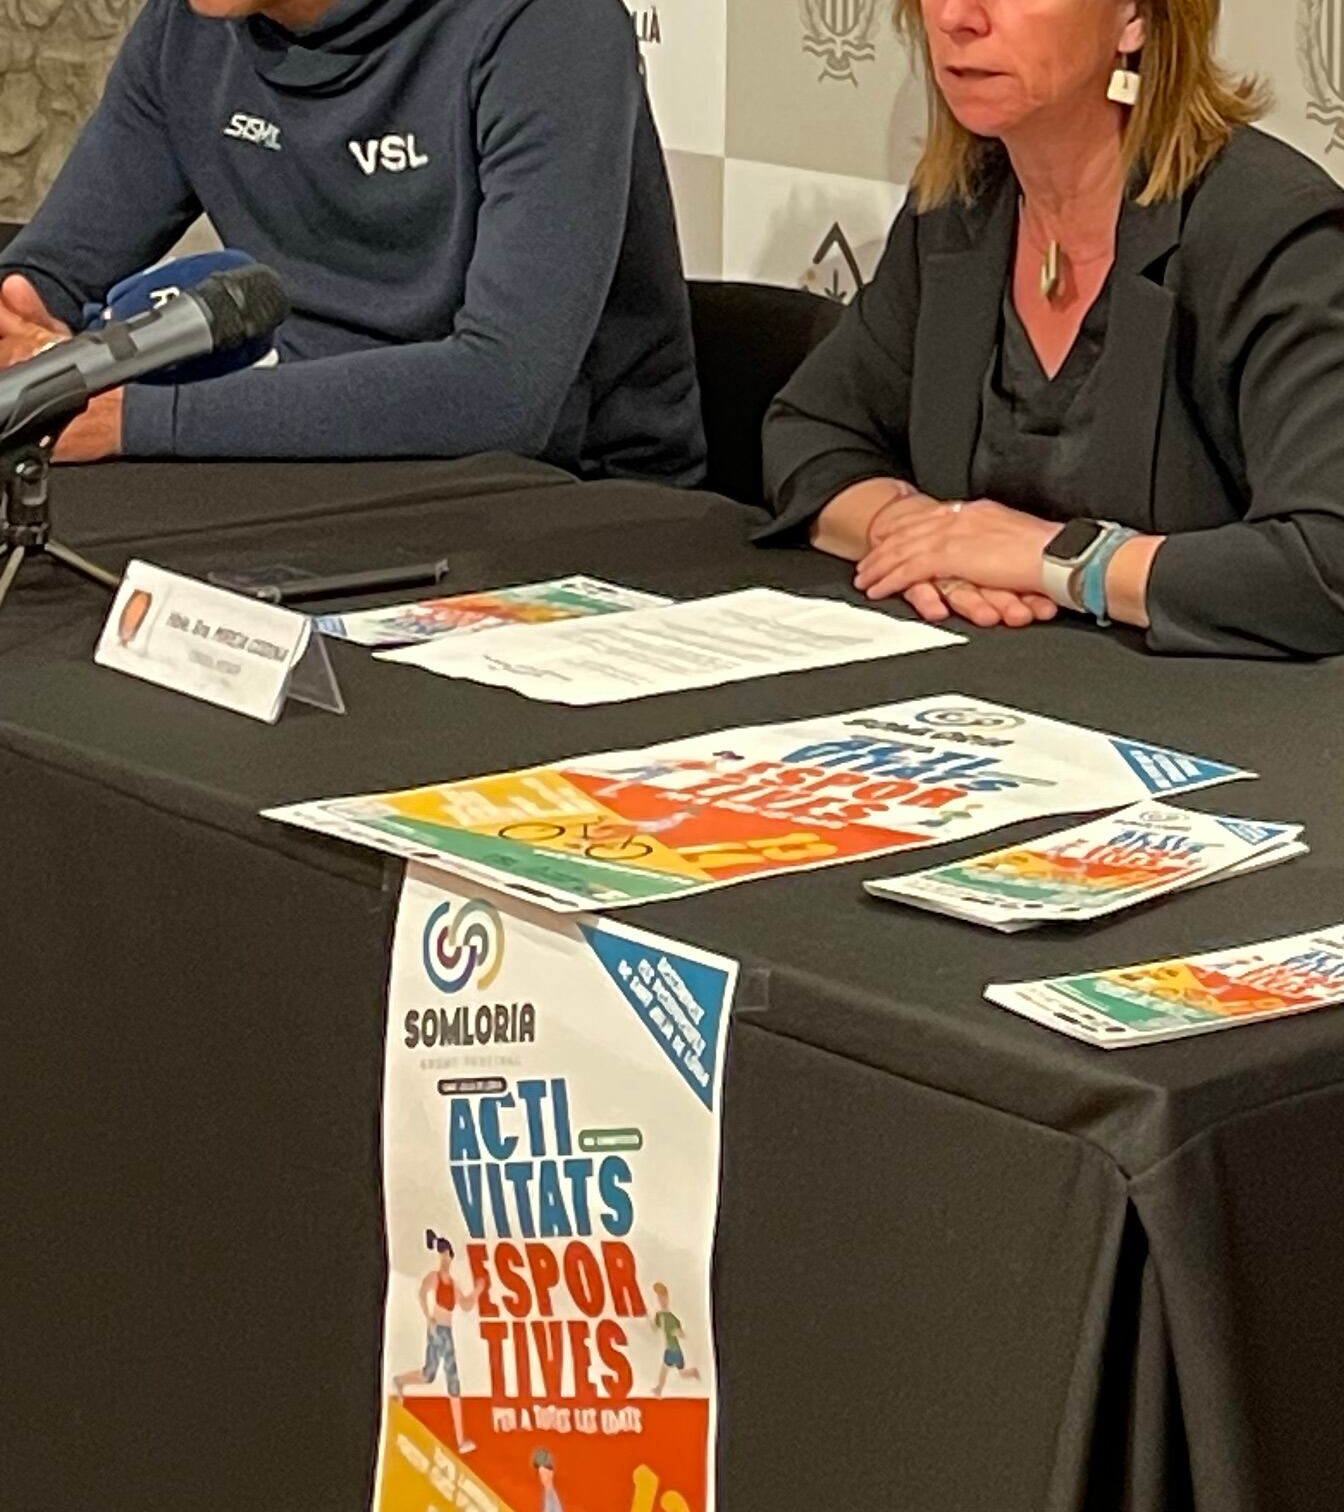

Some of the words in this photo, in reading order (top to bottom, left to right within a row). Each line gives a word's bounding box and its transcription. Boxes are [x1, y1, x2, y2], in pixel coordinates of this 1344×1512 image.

[348, 133, 429, 176] VSL
[403, 1002, 537, 1050] SOMLORIA
[450, 1077, 573, 1161] ACTI
[449, 1154, 635, 1239] VITATS
[465, 1239, 648, 1319] ESPOR
[479, 1318, 635, 1401] TIVES
